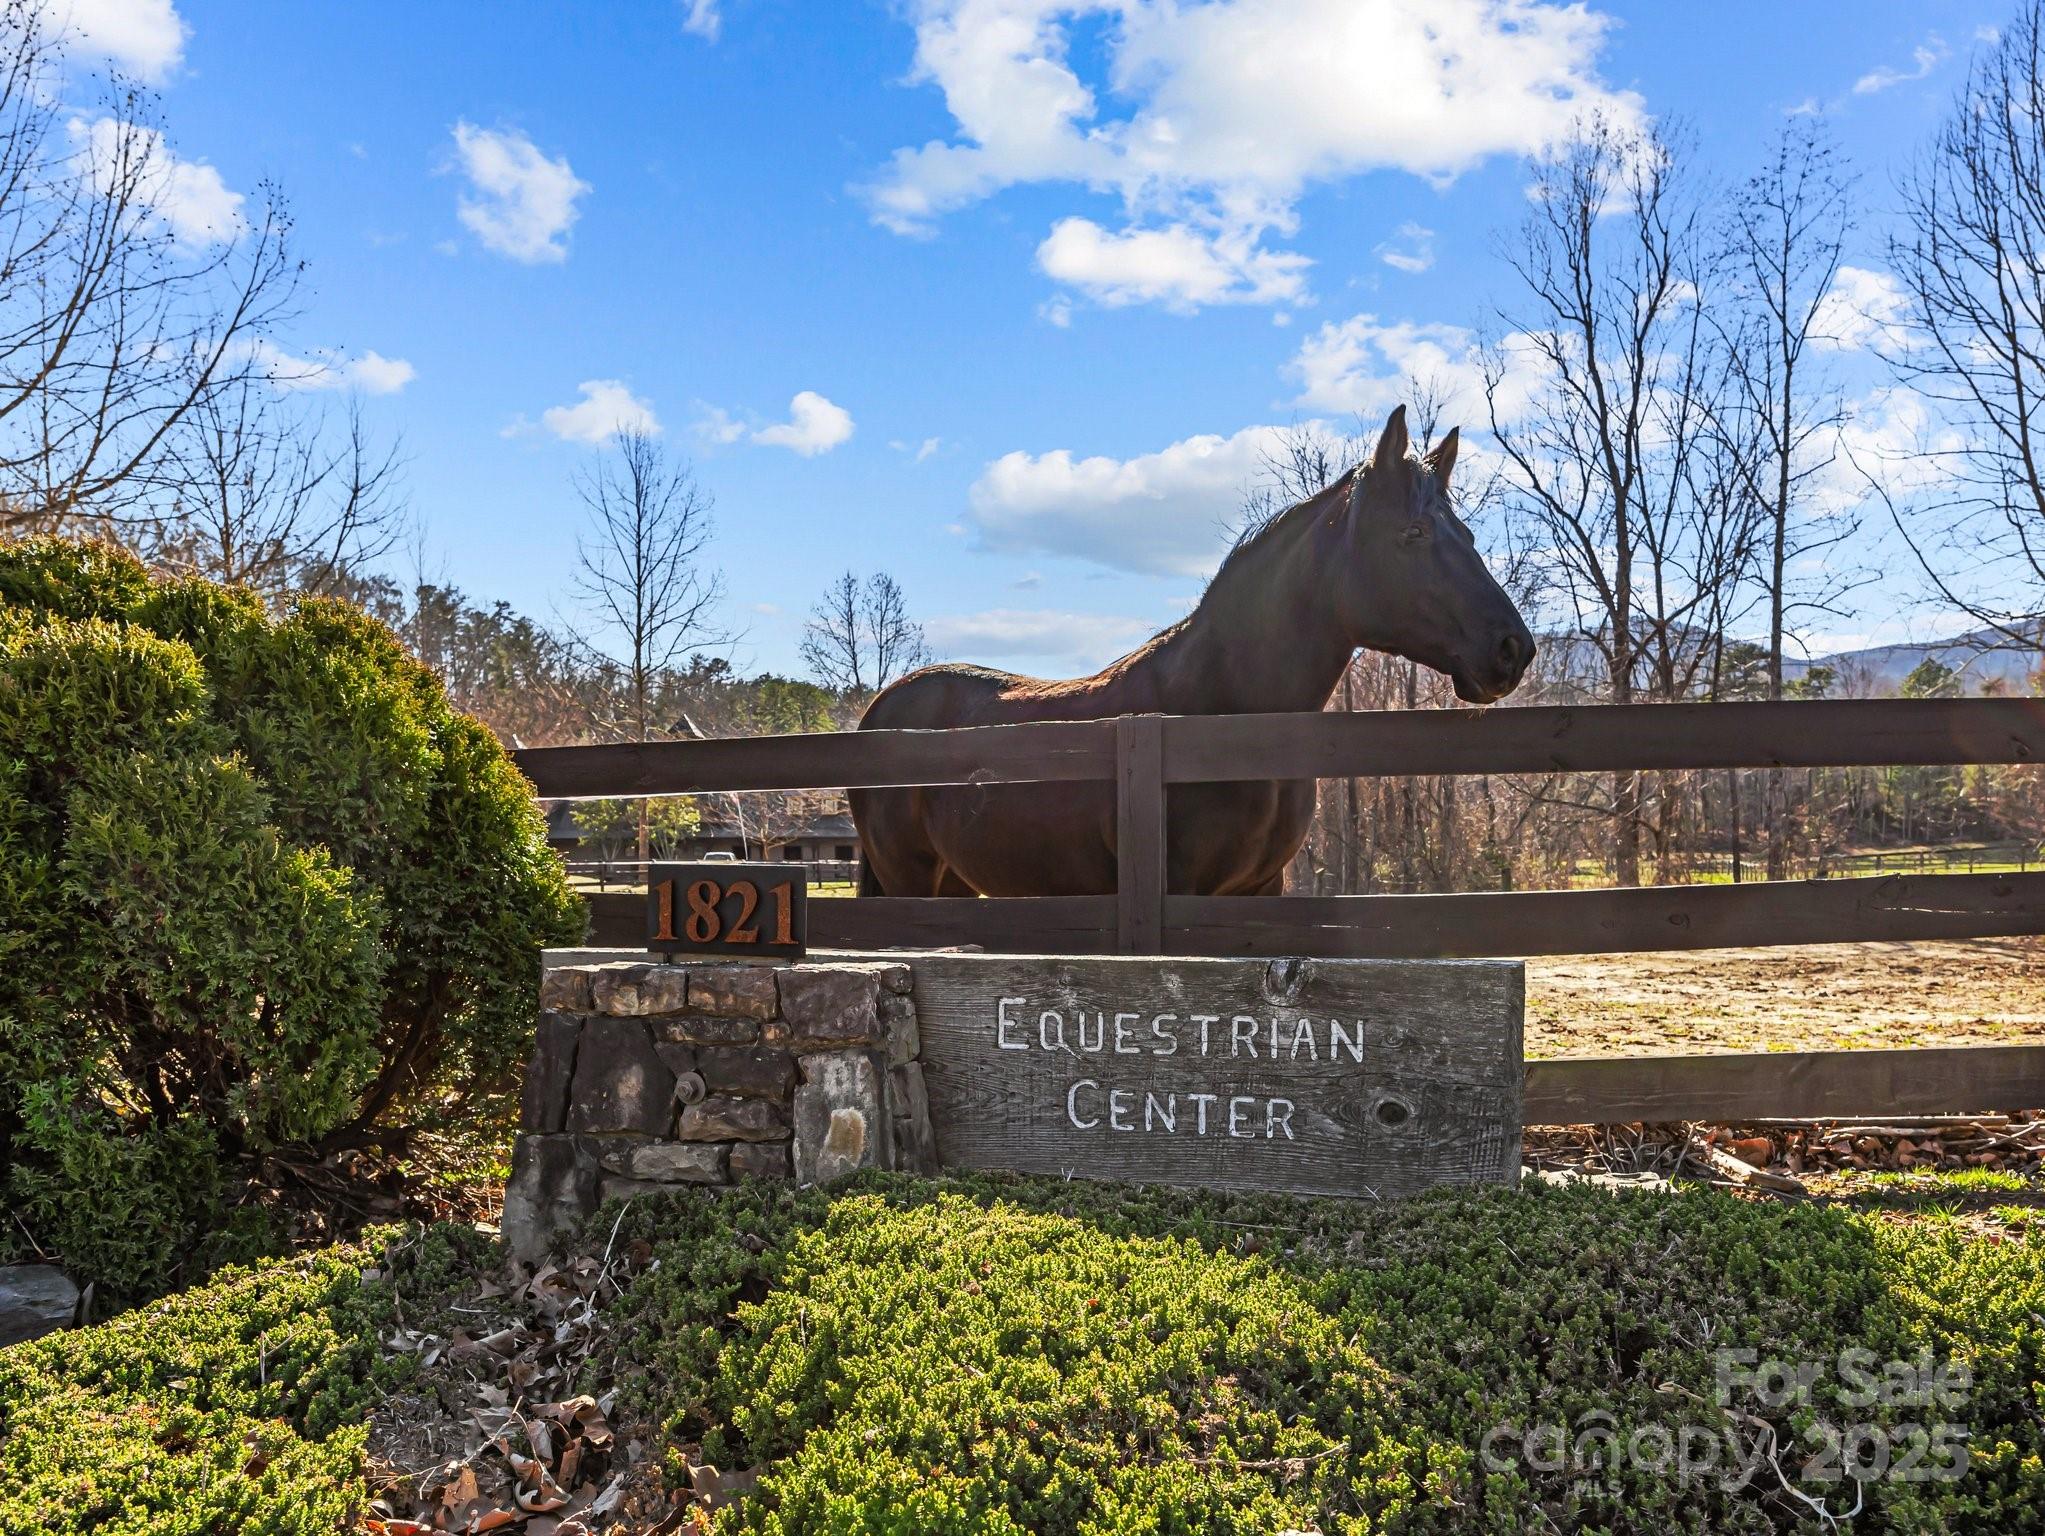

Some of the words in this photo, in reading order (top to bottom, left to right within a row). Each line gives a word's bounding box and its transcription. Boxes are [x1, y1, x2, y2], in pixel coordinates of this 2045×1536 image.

[652, 879, 800, 945] 1821
[997, 997, 1364, 1063] EQUESTRIAN
[1066, 1078, 1296, 1141] CENTER
